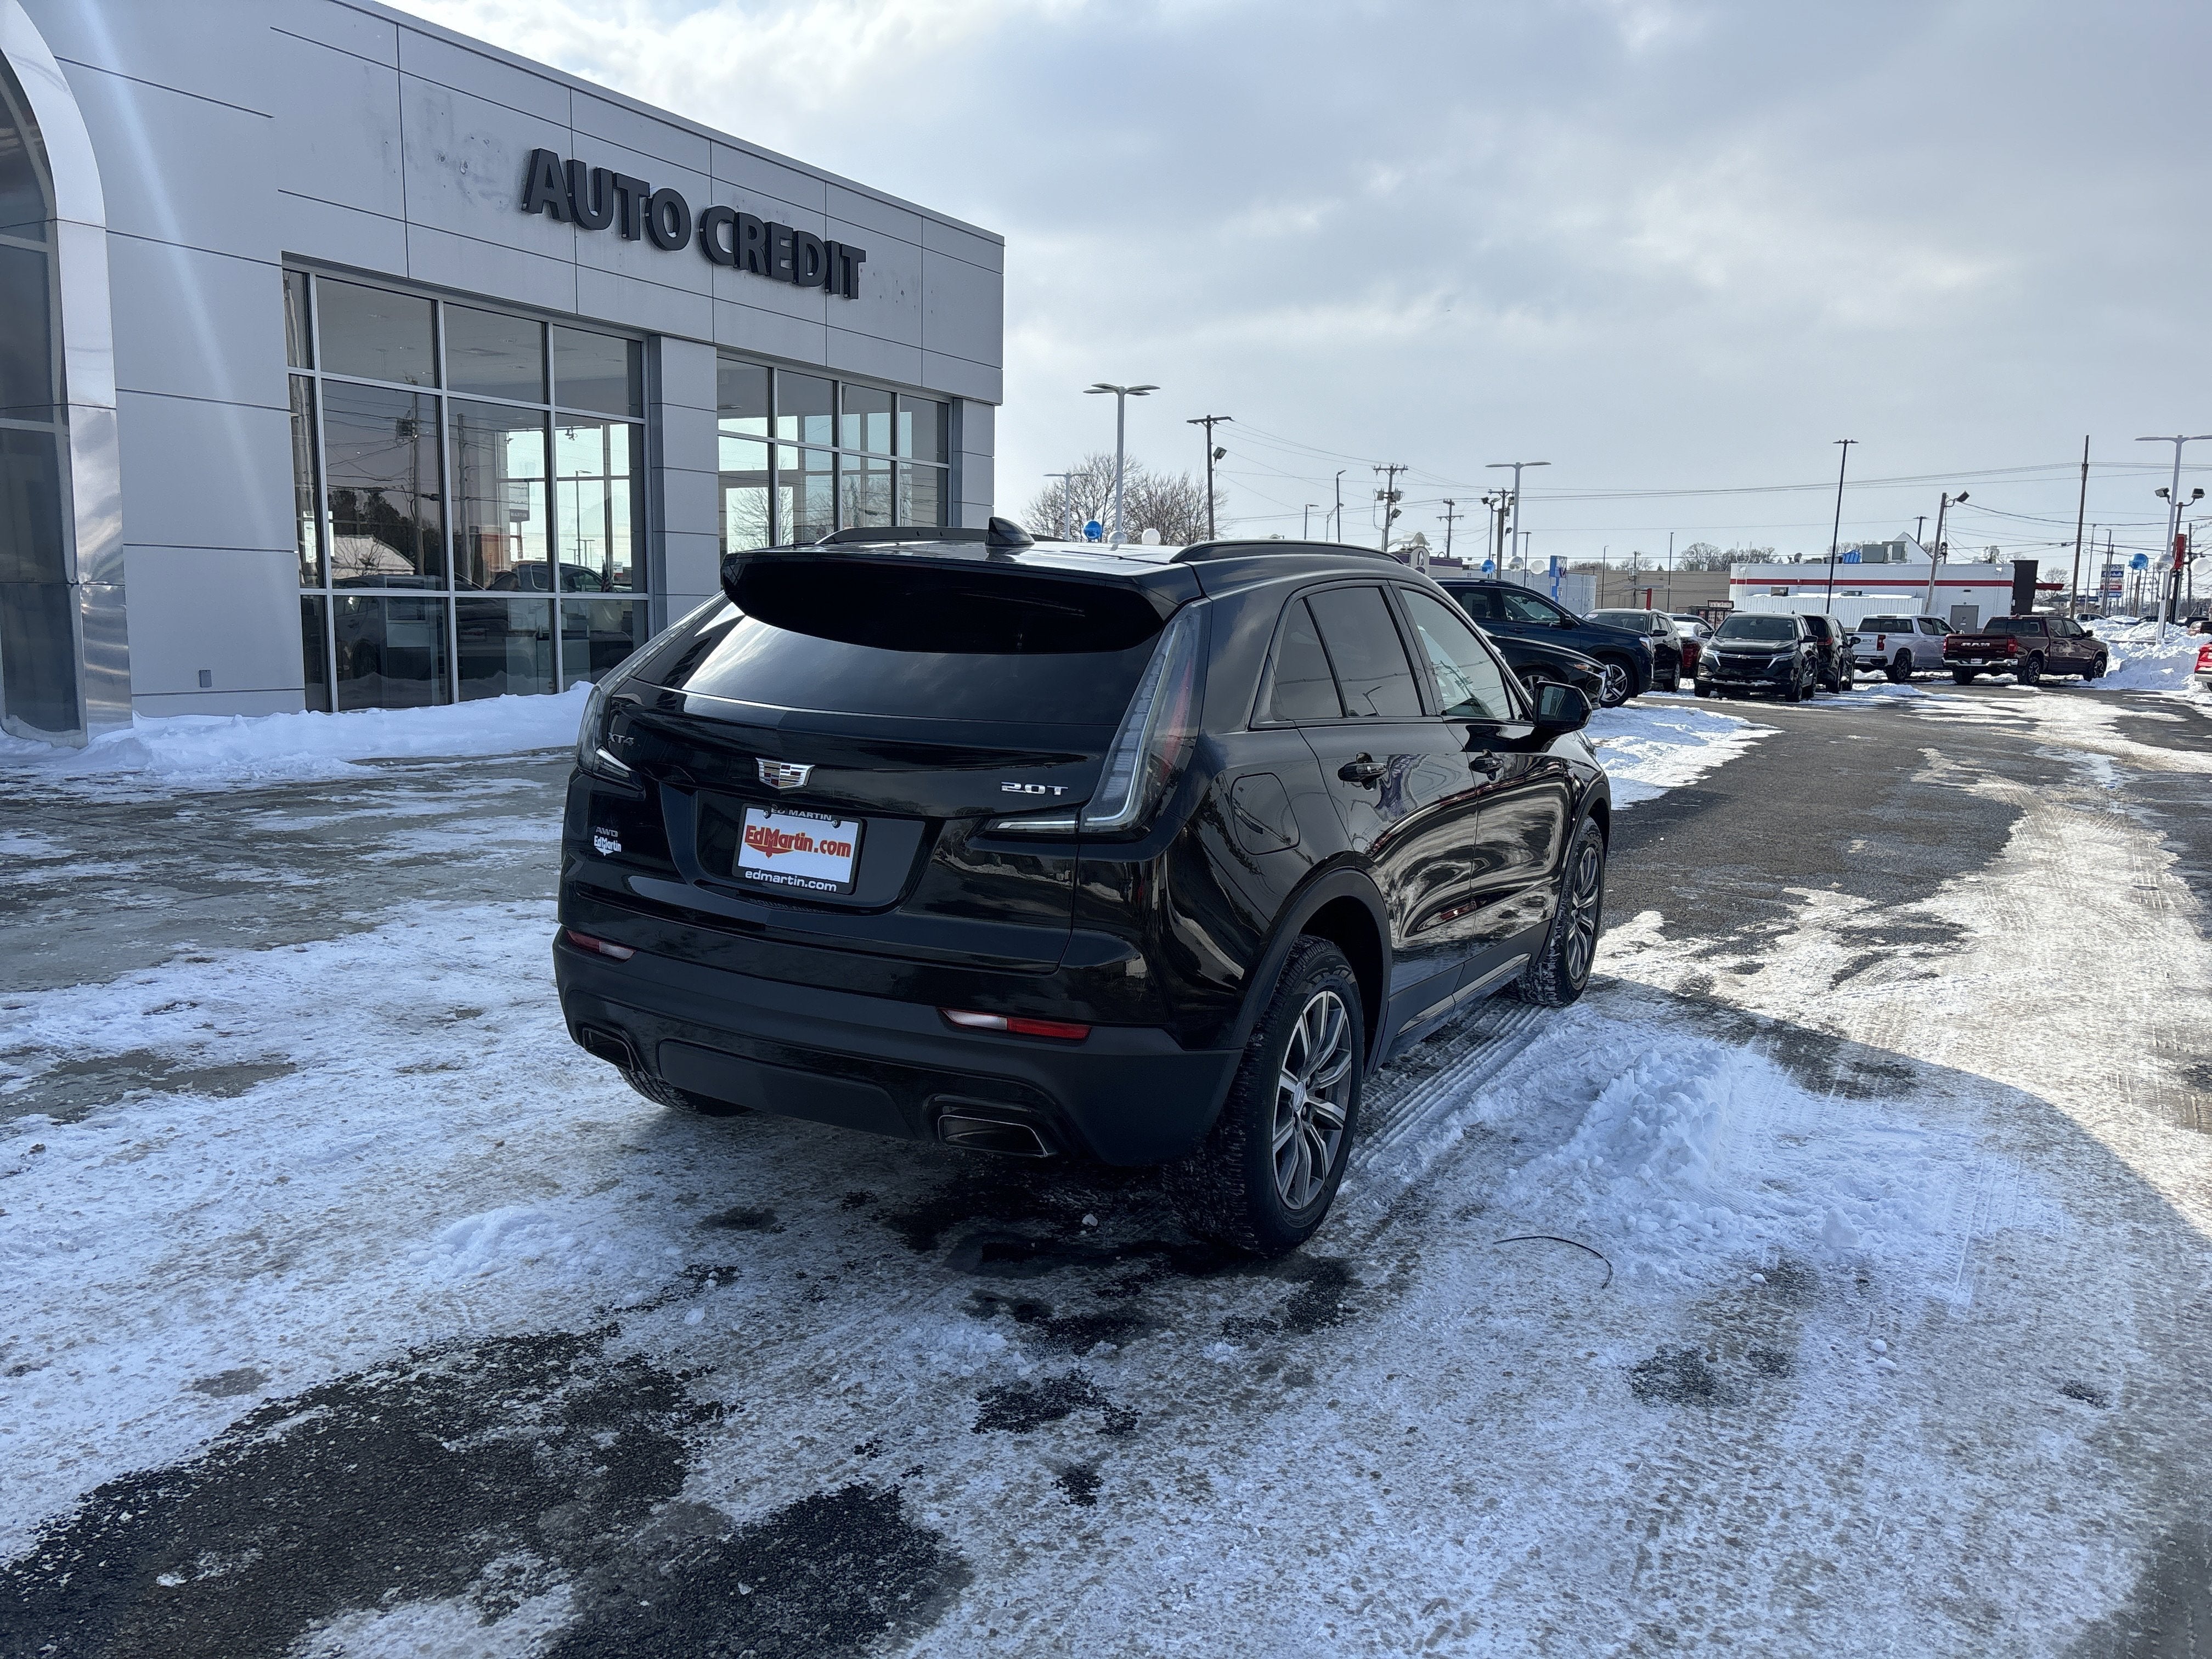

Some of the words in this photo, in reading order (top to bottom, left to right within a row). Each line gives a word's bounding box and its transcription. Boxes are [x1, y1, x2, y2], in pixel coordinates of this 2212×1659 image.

[522, 148, 691, 251] AUTO
[699, 205, 866, 300] CREDIT
[607, 732, 634, 746] XT4
[788, 809, 832, 821] MARTIN
[595, 826, 618, 837] AWD
[744, 825, 851, 857] EdMartin.com
[745, 870, 837, 892] edmartin.com
